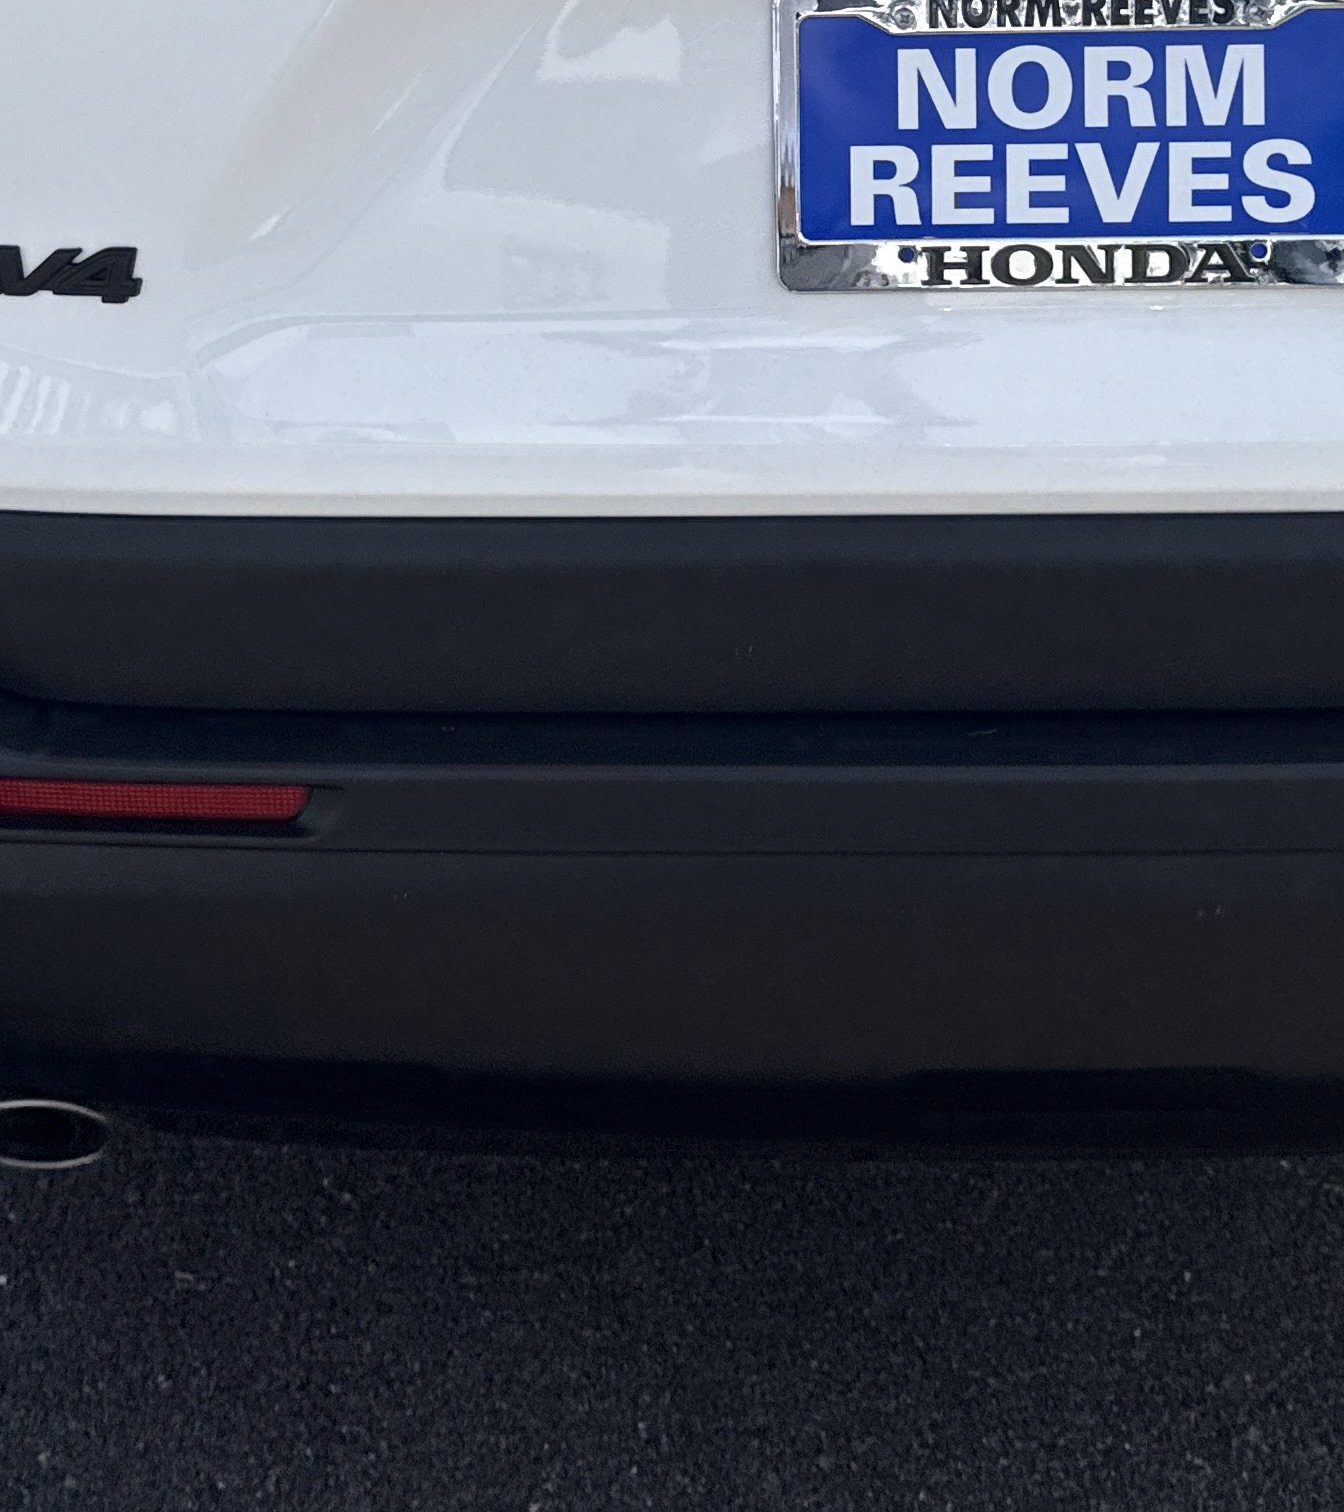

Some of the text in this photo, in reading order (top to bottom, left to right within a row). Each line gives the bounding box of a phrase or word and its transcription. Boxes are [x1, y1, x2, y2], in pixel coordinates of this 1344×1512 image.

[897, 44, 1265, 130] NORM
[849, 139, 1316, 226] REEVES
[921, 243, 1258, 286] HONDA
